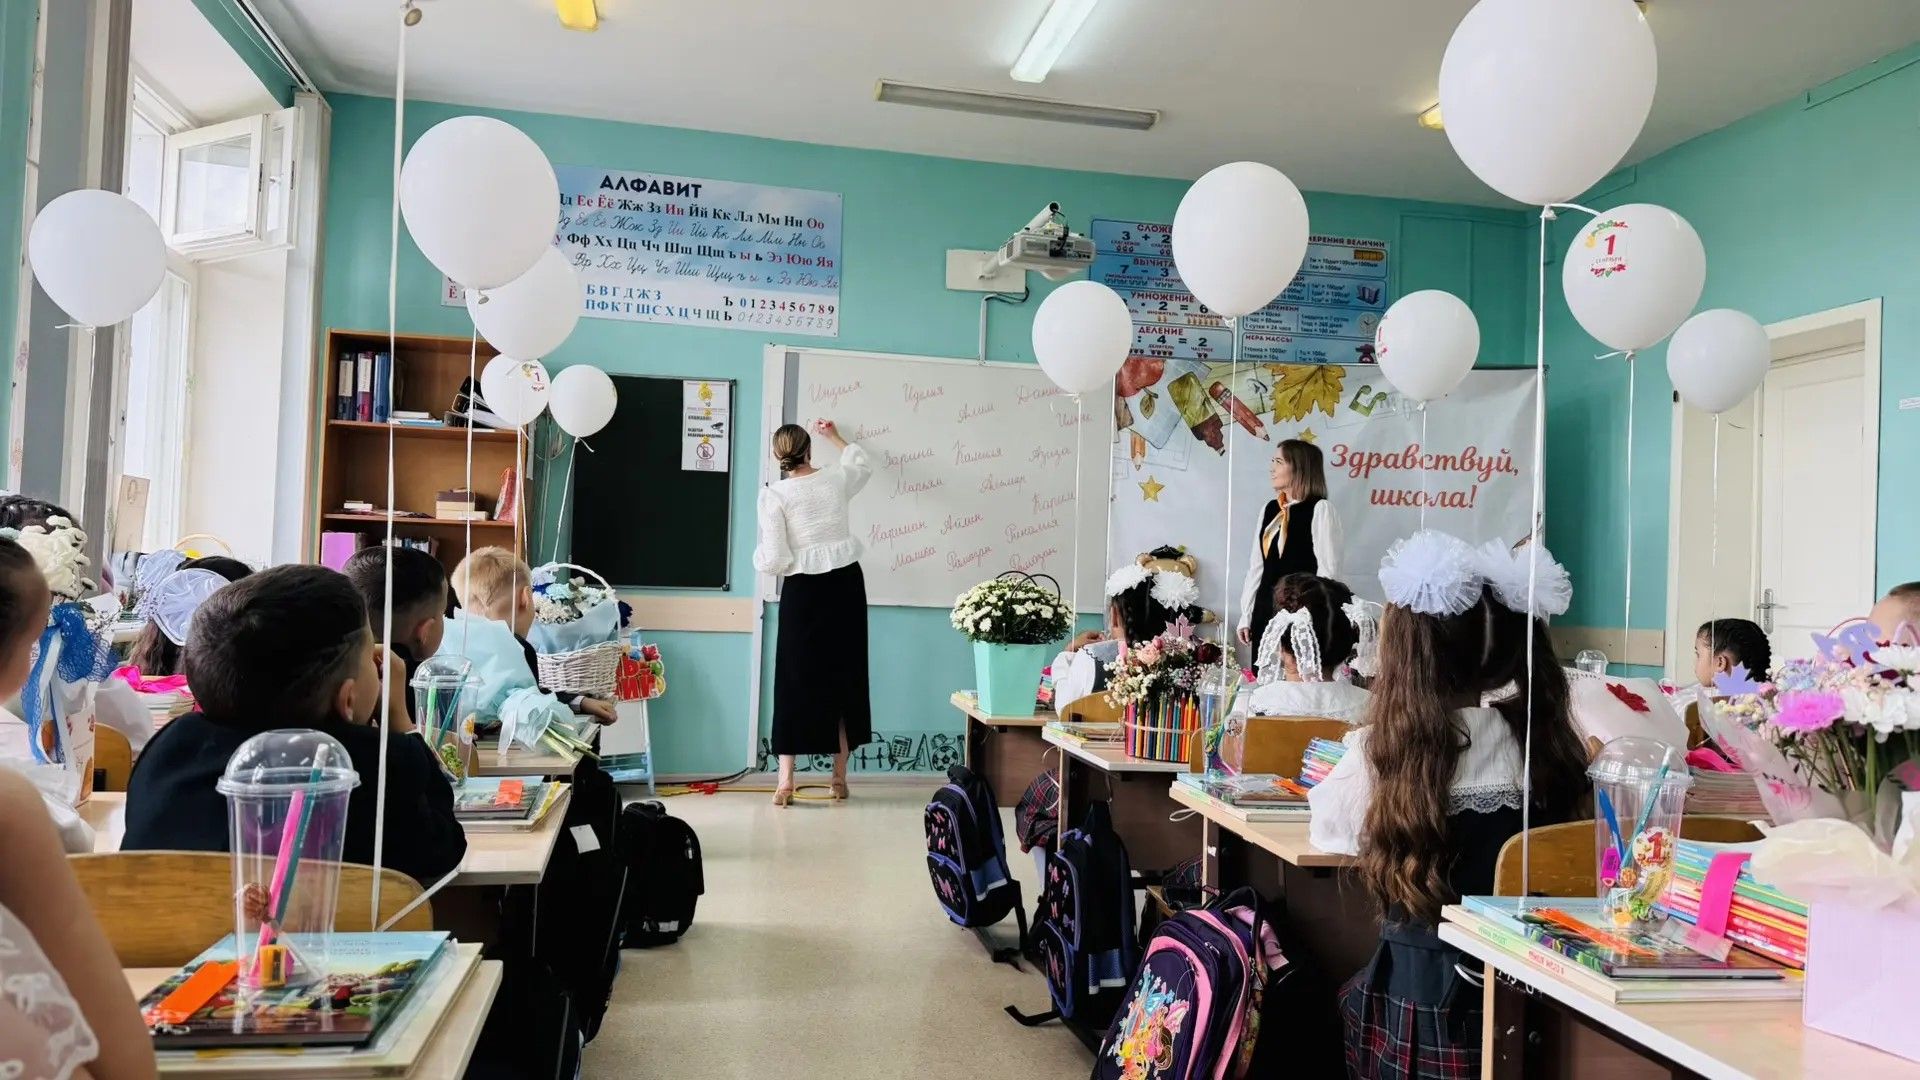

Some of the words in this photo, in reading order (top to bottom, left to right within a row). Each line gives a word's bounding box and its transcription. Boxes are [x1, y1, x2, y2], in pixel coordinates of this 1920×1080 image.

[600, 175, 702, 198] АЛФАВИТ
[618, 199, 643, 212] Жж
[647, 202, 661, 213] Зз
[665, 204, 684, 216] Ии
[689, 203, 708, 218] Йй
[713, 208, 731, 220] Кк
[734, 211, 753, 222] Лл
[758, 213, 780, 225] Мм
[784, 215, 803, 228] Нн
[807, 218, 825, 230] Оо
[1137, 224, 1172, 234] СЛОЖЕ
[1122, 231, 1130, 240] 3
[1161, 234, 1171, 244] 2
[1309, 235, 1344, 245] ЕРЕНИЯ
[1346, 238, 1385, 248] ВЕЛИЧИН
[567, 233, 590, 248] Фф
[595, 235, 612, 247] Хх
[618, 237, 636, 251] Цц
[642, 240, 659, 252] Чч
[665, 242, 692, 255] Шш
[697, 245, 724, 259] Щщ
[767, 251, 782, 263] Ээ
[787, 253, 812, 266] Юю
[816, 256, 833, 268] Яя
[1605, 234, 1616, 255] 1
[1134, 258, 1176, 268] ВЫЧИТА
[1120, 265, 1129, 274] 7
[1160, 268, 1169, 277] 3
[1130, 291, 1195, 303] УМНОЖЕНИЕ
[1159, 301, 1168, 310] 2
[1200, 304, 1208, 313] 6
[1138, 326, 1183, 336] ДЕЛЕНИЕ
[1157, 335, 1166, 344] 4
[1198, 338, 1207, 347] 2
[1330, 442, 1520, 483] Здравствуй,
[1369, 484, 1477, 509] школа!
[1648, 832, 1665, 864] 1
